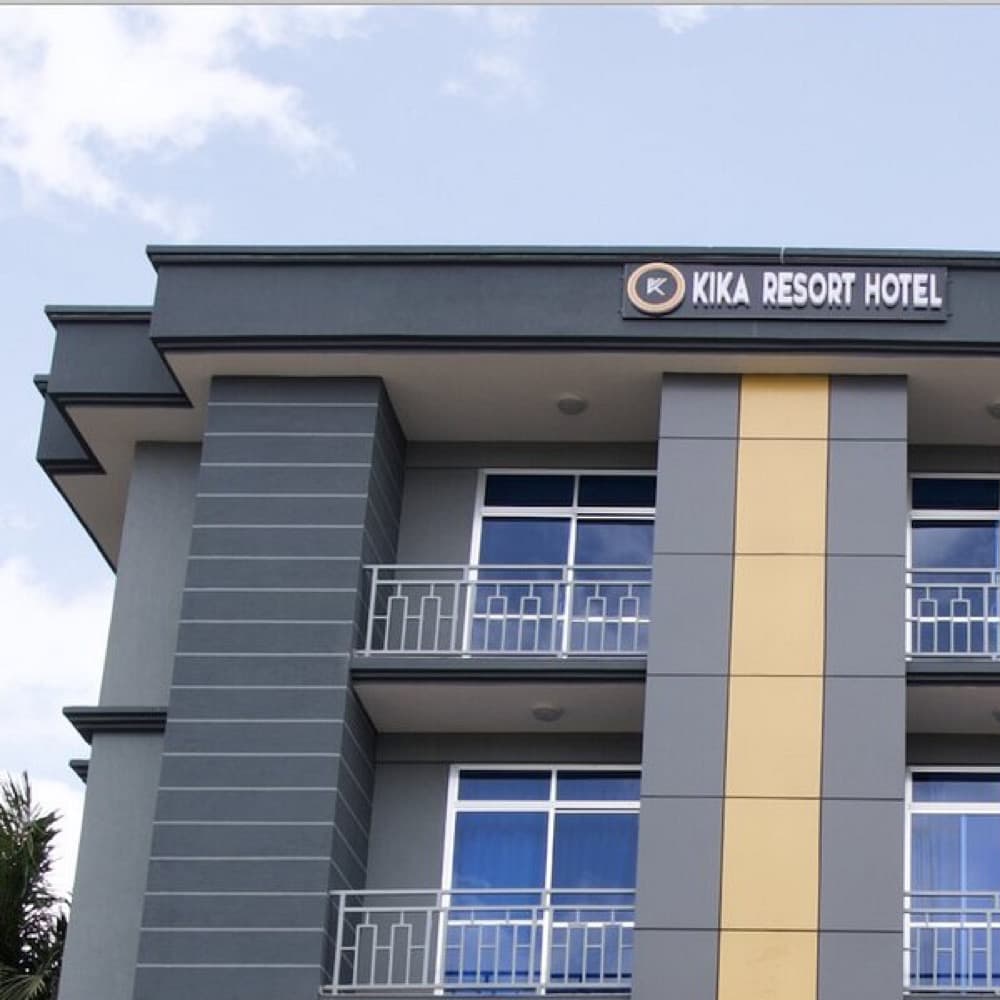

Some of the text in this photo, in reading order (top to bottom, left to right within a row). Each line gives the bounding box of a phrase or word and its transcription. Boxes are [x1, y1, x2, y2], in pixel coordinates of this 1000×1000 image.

[692, 271, 943, 308] KIKA RESORT HOTEL
